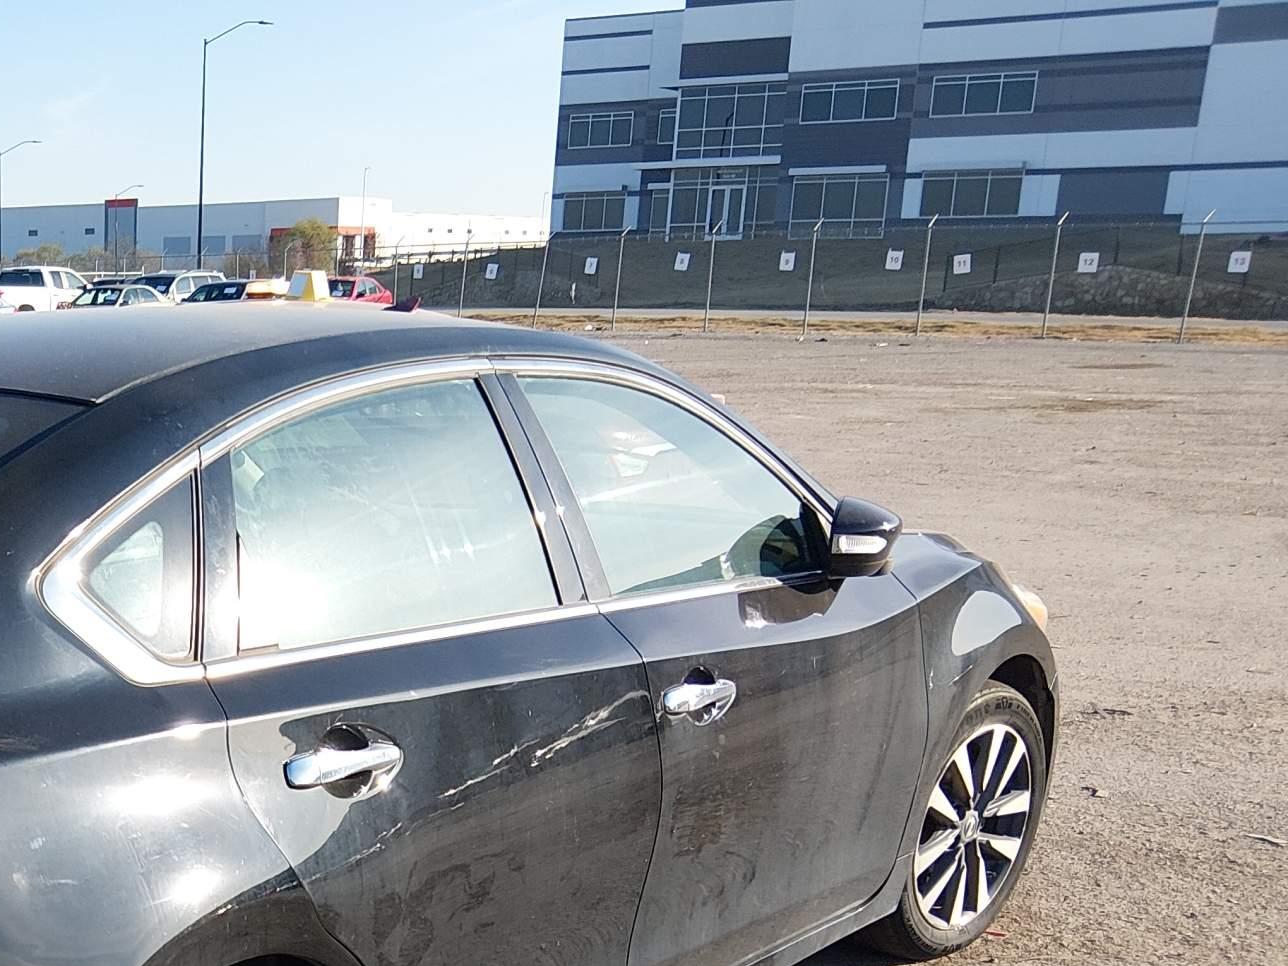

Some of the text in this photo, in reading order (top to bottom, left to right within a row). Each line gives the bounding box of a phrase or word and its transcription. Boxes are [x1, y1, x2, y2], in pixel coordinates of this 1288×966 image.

[890, 256, 900, 265] 10
[1083, 258, 1095, 266] 12
[1234, 257, 1246, 267] 13
